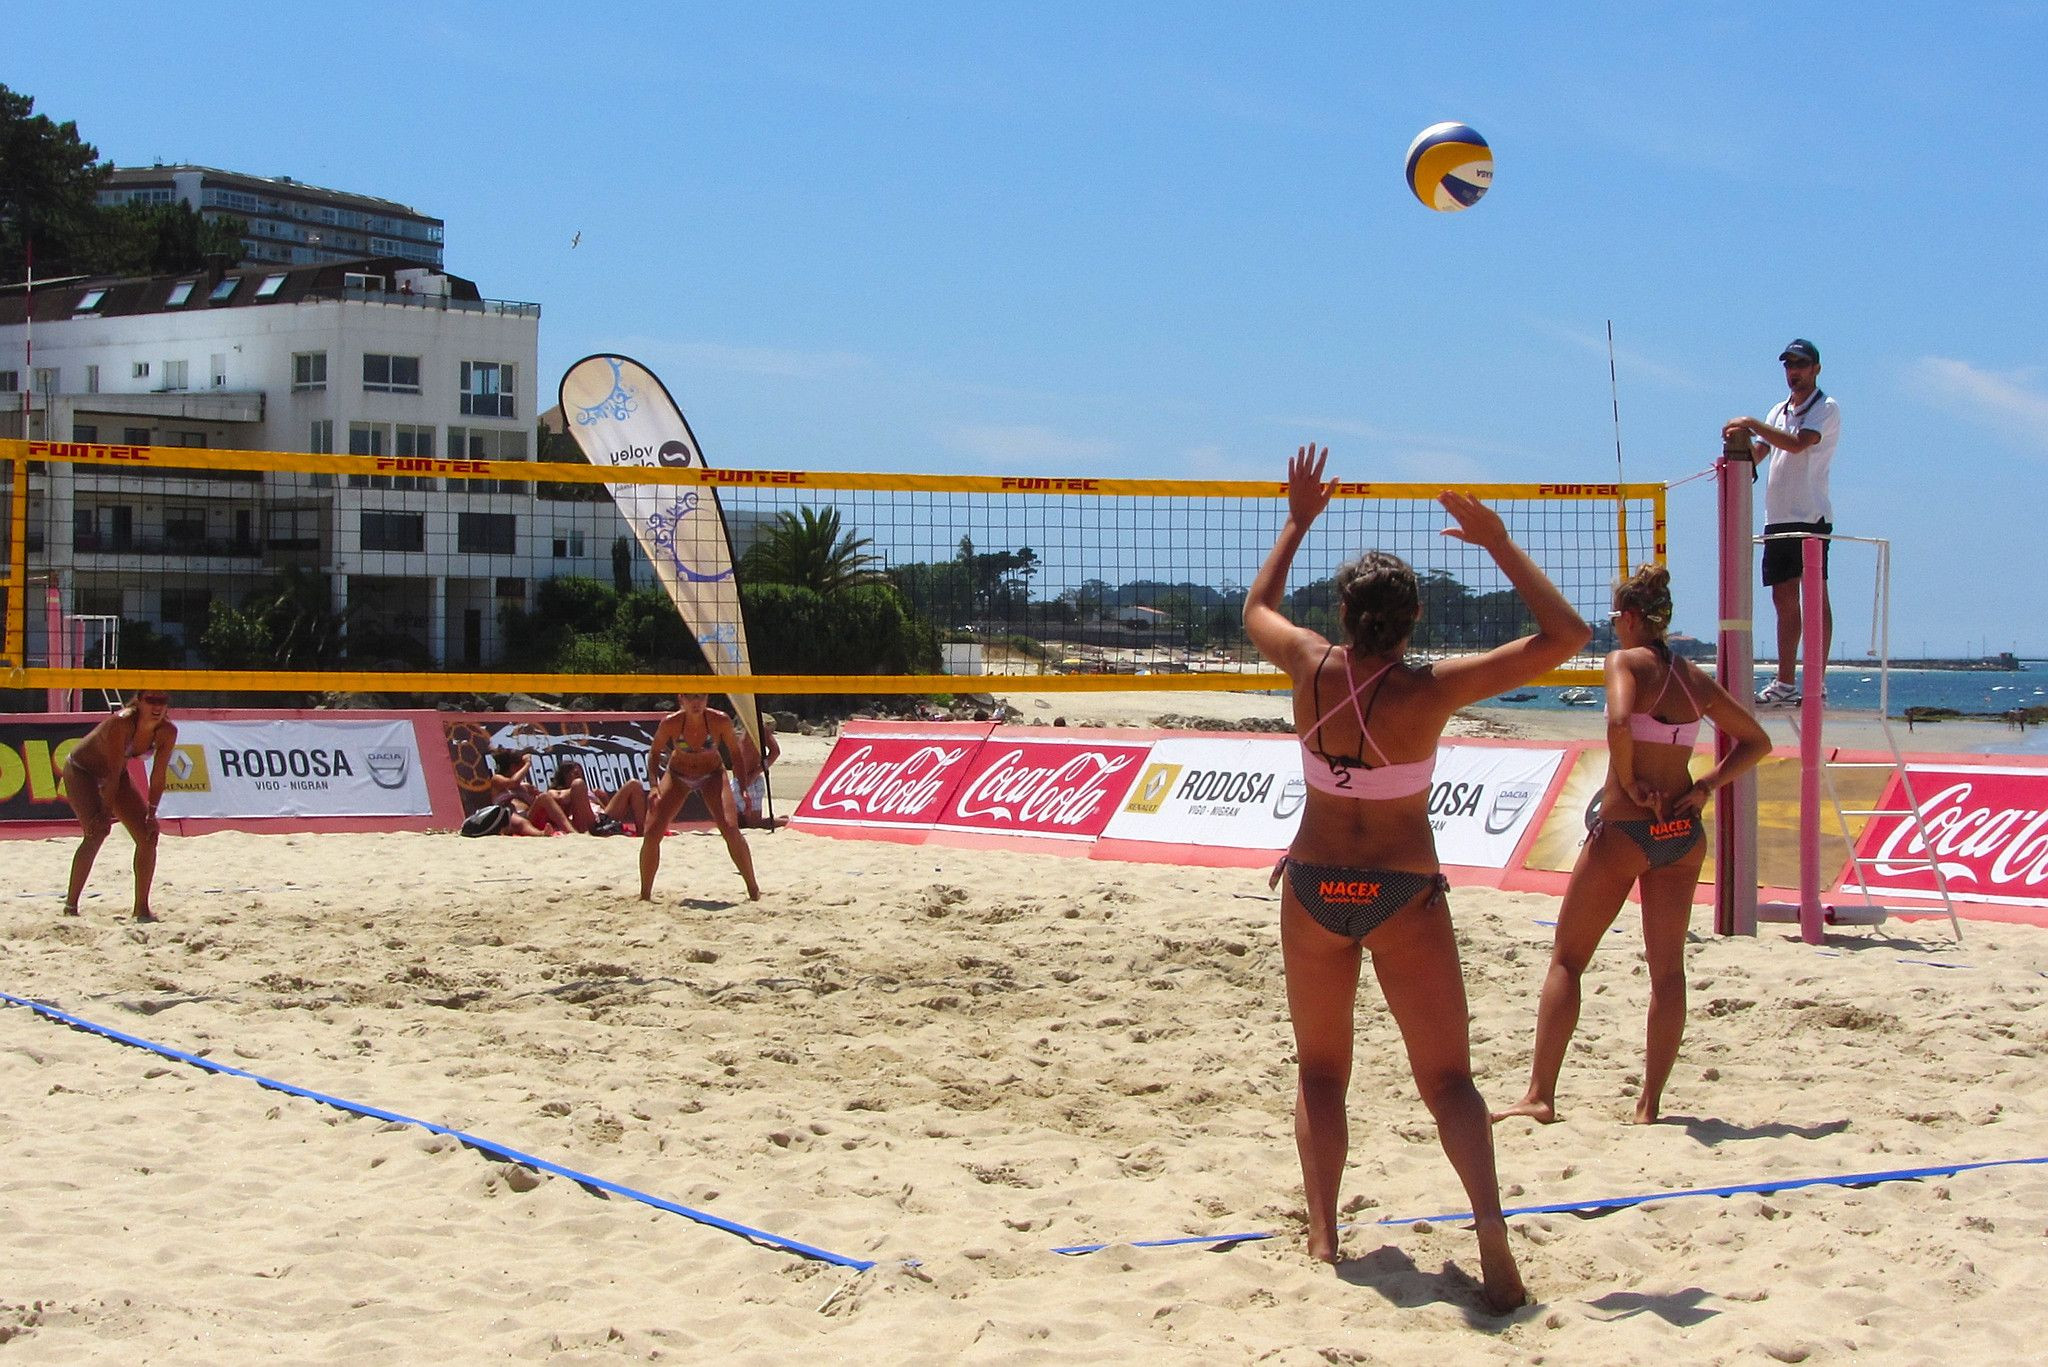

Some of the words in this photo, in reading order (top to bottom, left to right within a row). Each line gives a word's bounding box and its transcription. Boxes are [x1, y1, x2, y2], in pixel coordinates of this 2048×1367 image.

[29, 442, 151, 460] FUNTEC
[377, 458, 491, 473] FUNTEC
[700, 470, 806, 484] FUNTEC
[1001, 477, 1100, 491] FUNTEC
[1671, 726, 1680, 745] 1
[219, 749, 354, 778] RODOSA
[255, 781, 280, 791] VIGO
[290, 781, 329, 790] NIGRAN
[812, 745, 969, 816] Coca-Cola
[956, 749, 1136, 826] Coca-Cola
[1175, 770, 1275, 804] RODOSA
[1335, 769, 1353, 790] 2
[1499, 790, 1529, 799] DACIA
[1650, 819, 1692, 836] NACEX
[1319, 881, 1381, 897] NACEX
